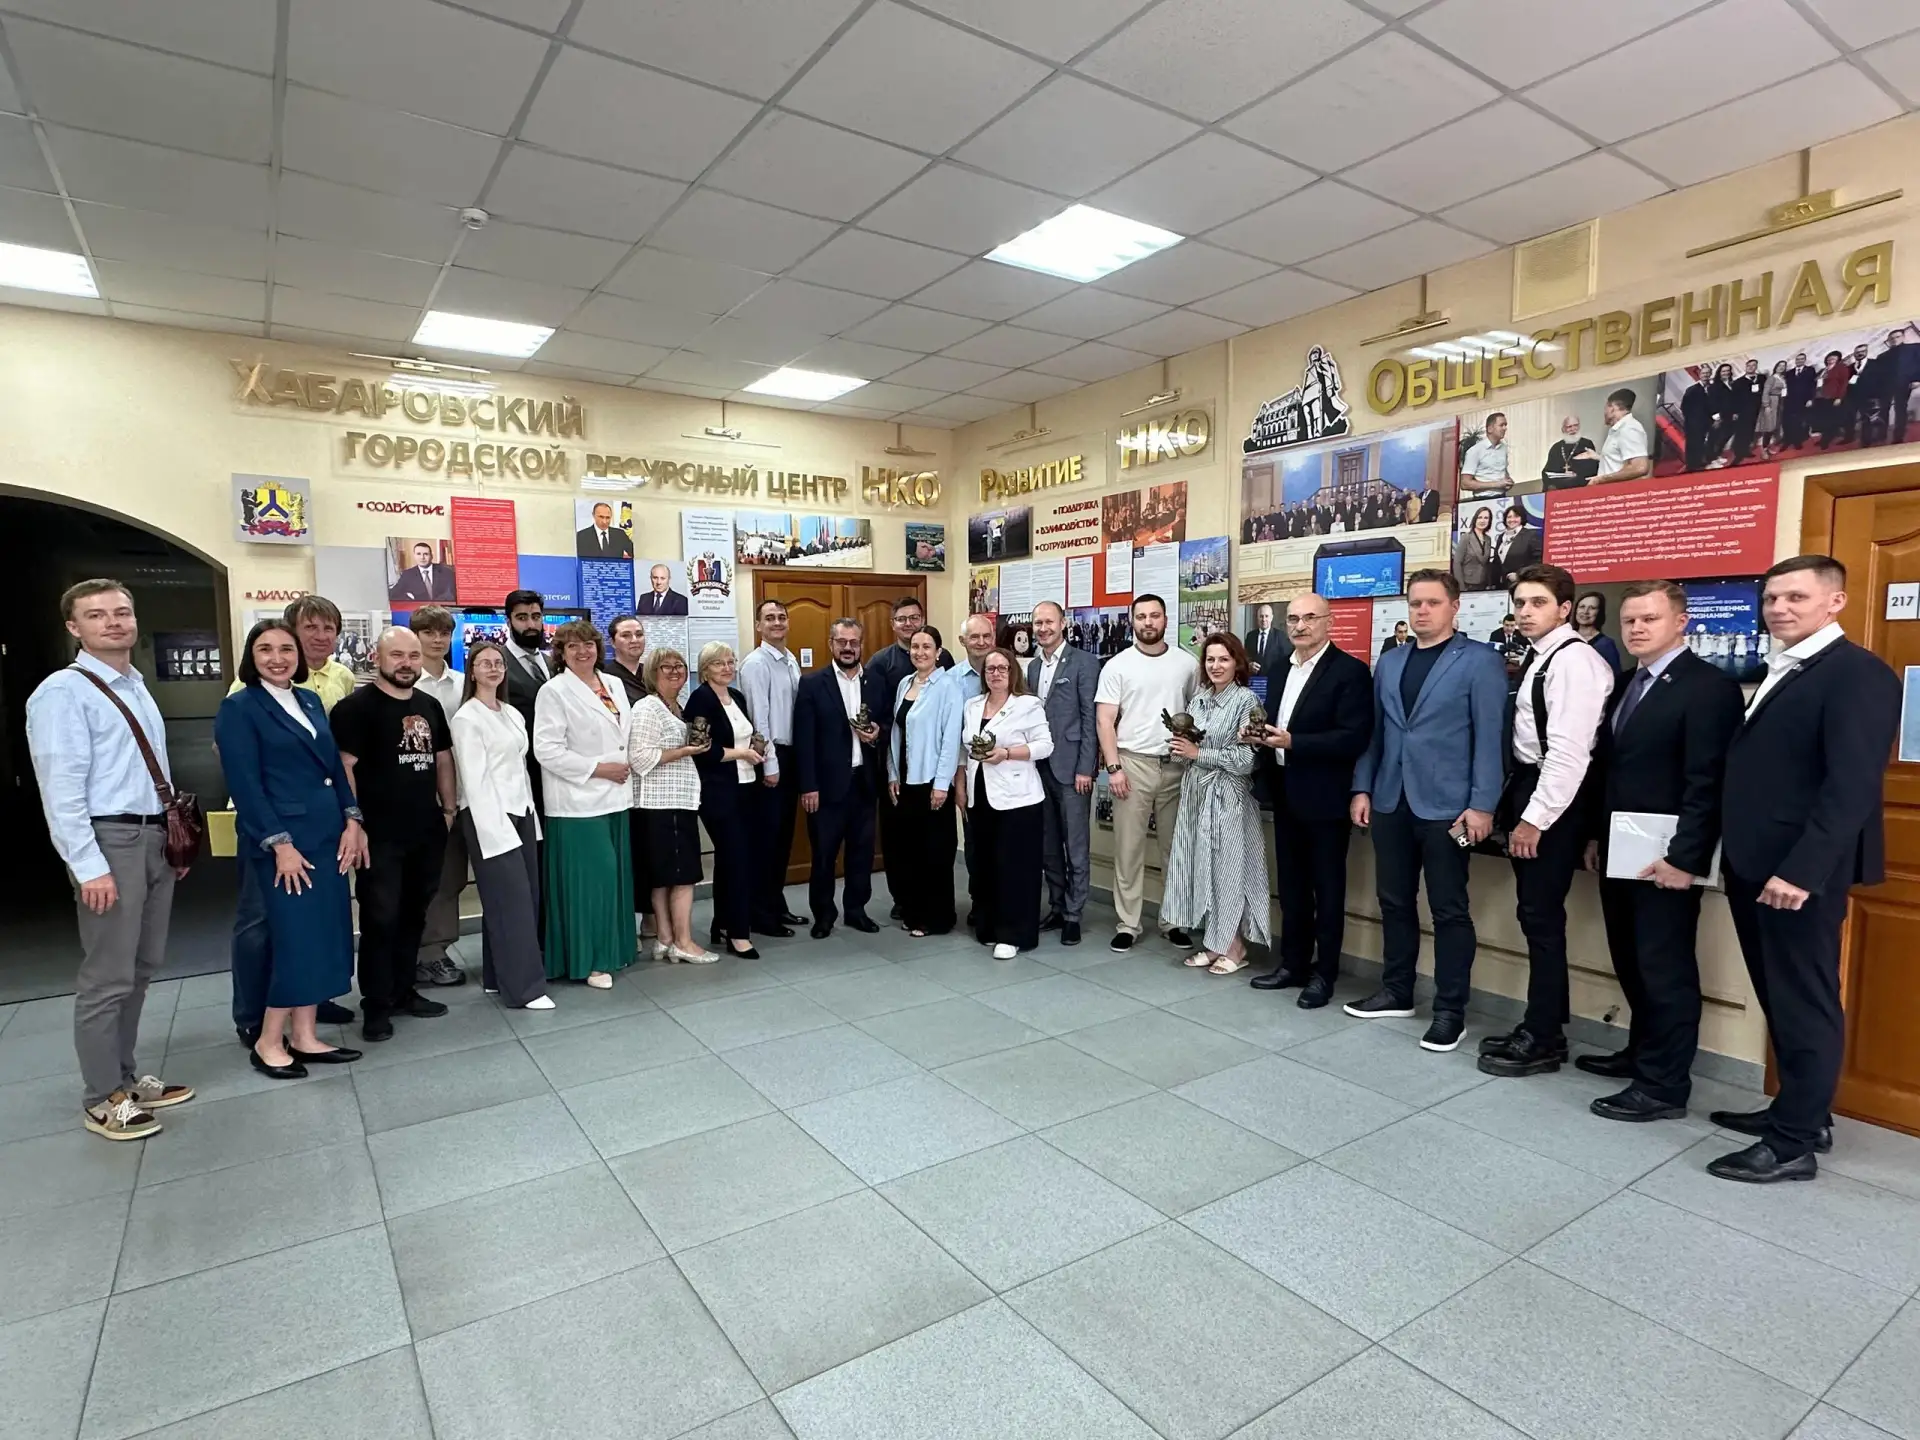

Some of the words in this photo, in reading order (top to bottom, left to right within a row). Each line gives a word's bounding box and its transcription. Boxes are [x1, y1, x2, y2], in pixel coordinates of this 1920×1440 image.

[1366, 240, 1894, 414] ОБЩЕСТВЕННАЯ
[229, 358, 585, 438] ХАБАРОВСКИЙ
[1120, 409, 1209, 469] НКО
[346, 431, 568, 481] ГОРОДСКОЙ
[586, 453, 759, 494] РЕСУРСНЫЙ
[767, 471, 848, 500] ЦЕНТР
[862, 466, 940, 506] НКО
[1606, 492, 1648, 501] Общественной
[1692, 482, 1730, 491] Хабаровска
[366, 500, 444, 516] СОДЕЙСТВИЕ
[1058, 500, 1098, 515] ПОДДЕРЖКА
[1041, 518, 1098, 534] ВЗАИМОДЕЙСТВИЕ
[1040, 536, 1098, 551] СОТРУДНИЧЕСТВО
[1891, 596, 1914, 607] 217
[1688, 611, 1734, 619] РИЗНАНИЕ»
